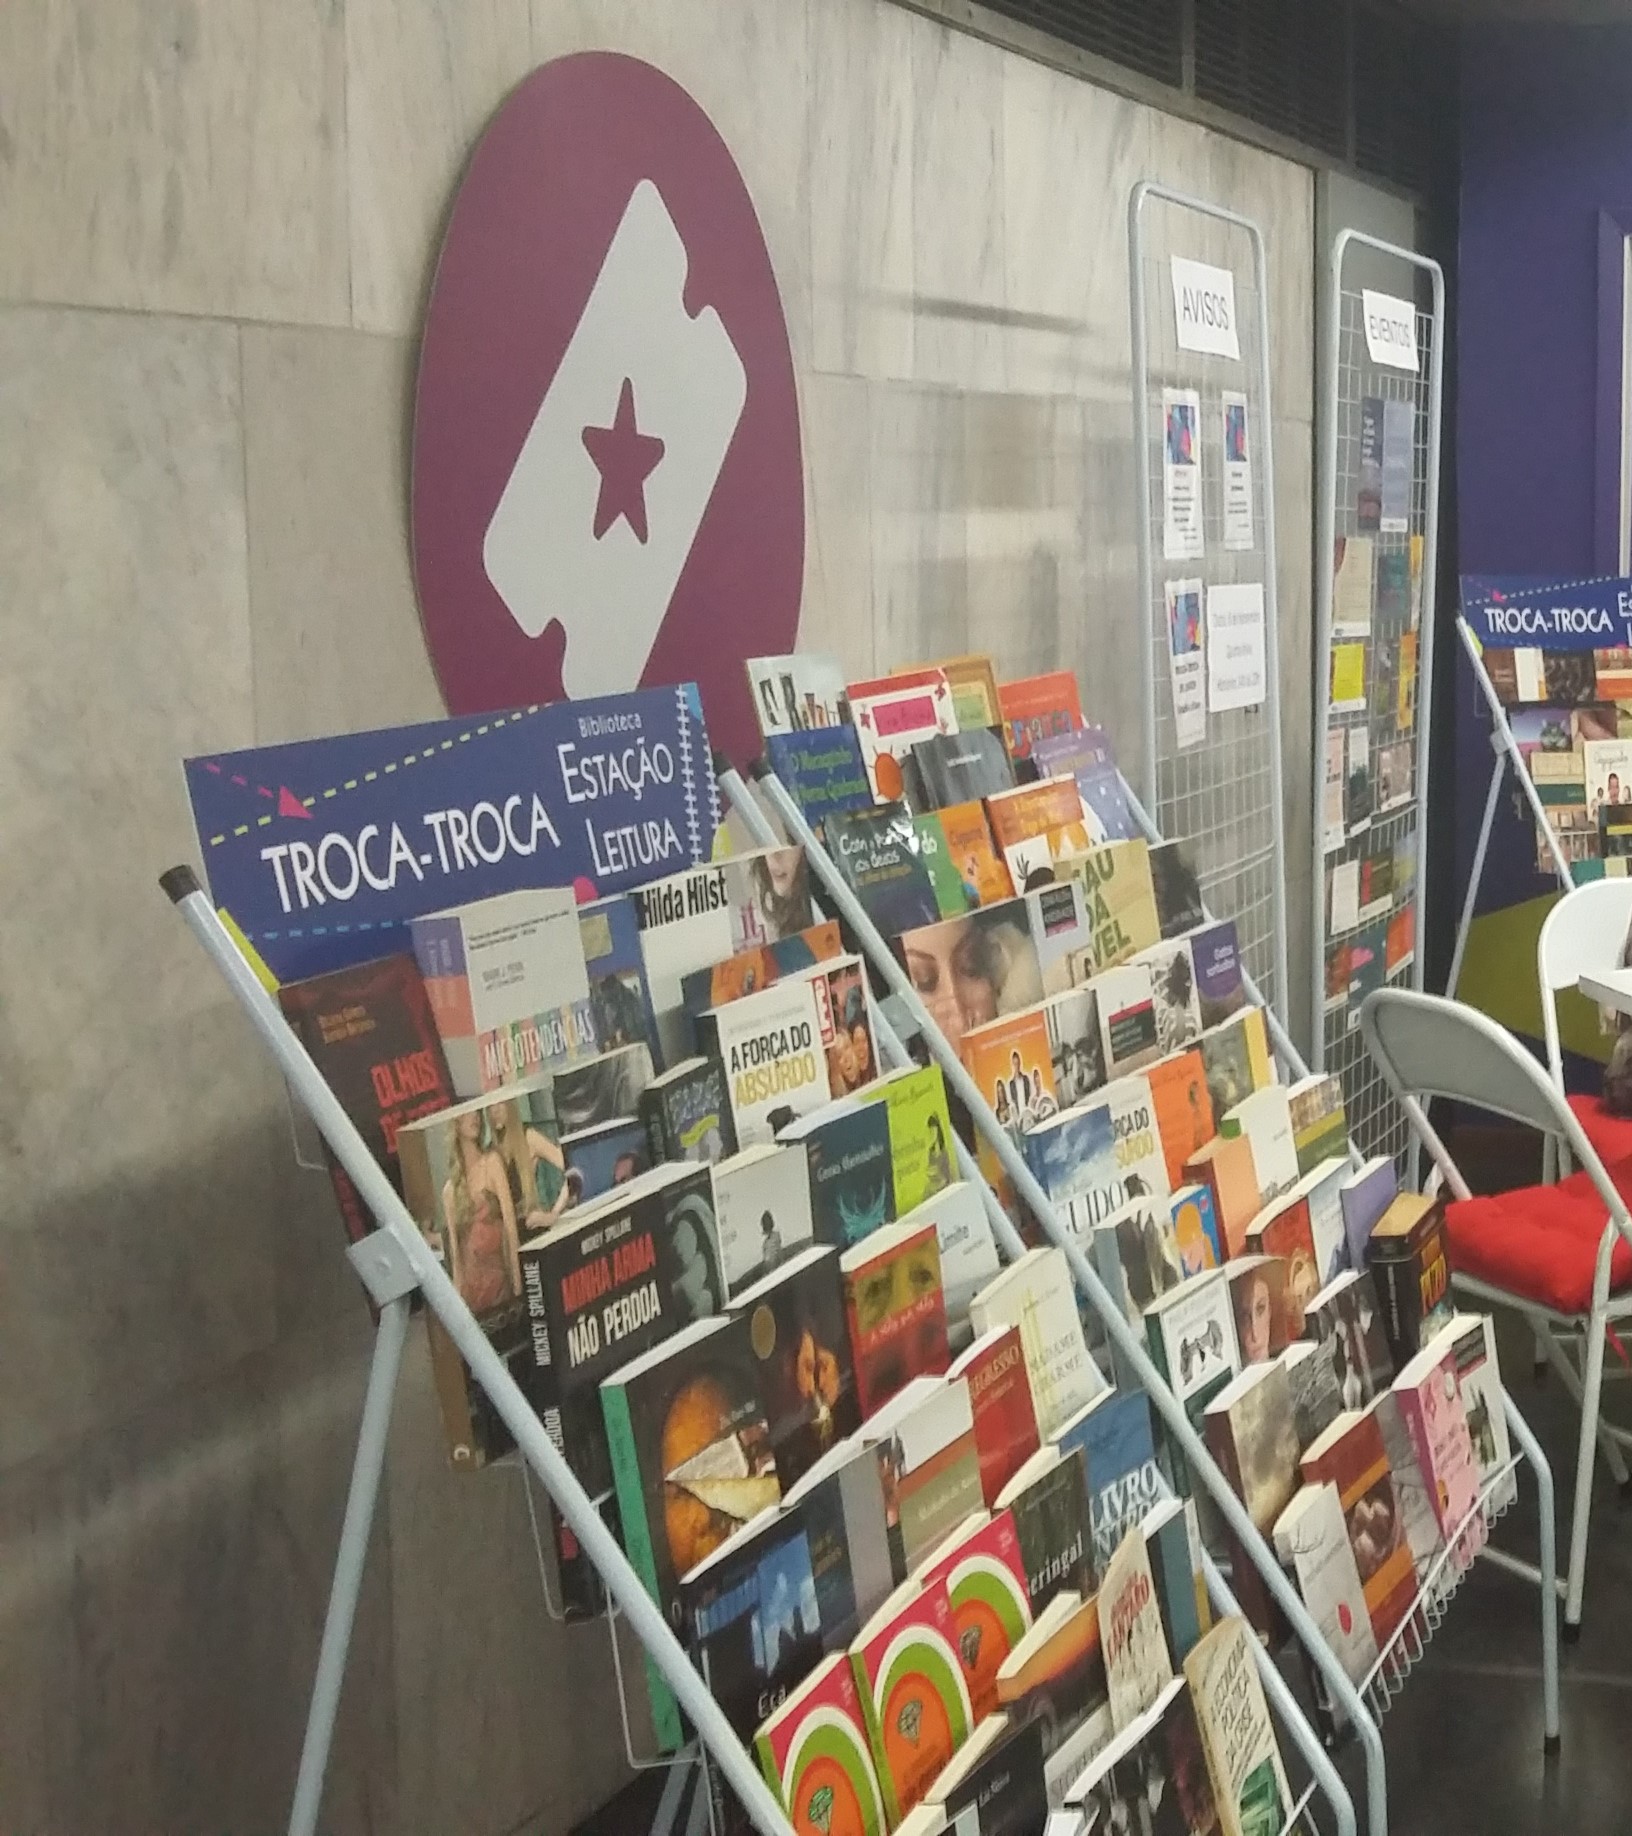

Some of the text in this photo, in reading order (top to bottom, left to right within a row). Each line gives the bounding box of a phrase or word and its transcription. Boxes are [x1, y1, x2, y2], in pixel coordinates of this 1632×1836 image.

[1182, 286, 1229, 331] AVISOS
[1369, 313, 1411, 349] EVENTOS
[1483, 606, 1614, 634] TROCA-TROCA
[577, 711, 643, 738] Biblioteca
[556, 736, 675, 806] ESTAÇÃO
[259, 792, 683, 914] TROCA-TROCA LEITURA
[642, 884, 686, 930] Hilda
[685, 869, 729, 918] Hilst
[730, 1021, 812, 1074] A FORÇA DO
[734, 1053, 817, 1108] ABSURDO
[566, 1279, 662, 1368] NÃO PERDOA
[1030, 1529, 1084, 1597] eringal
